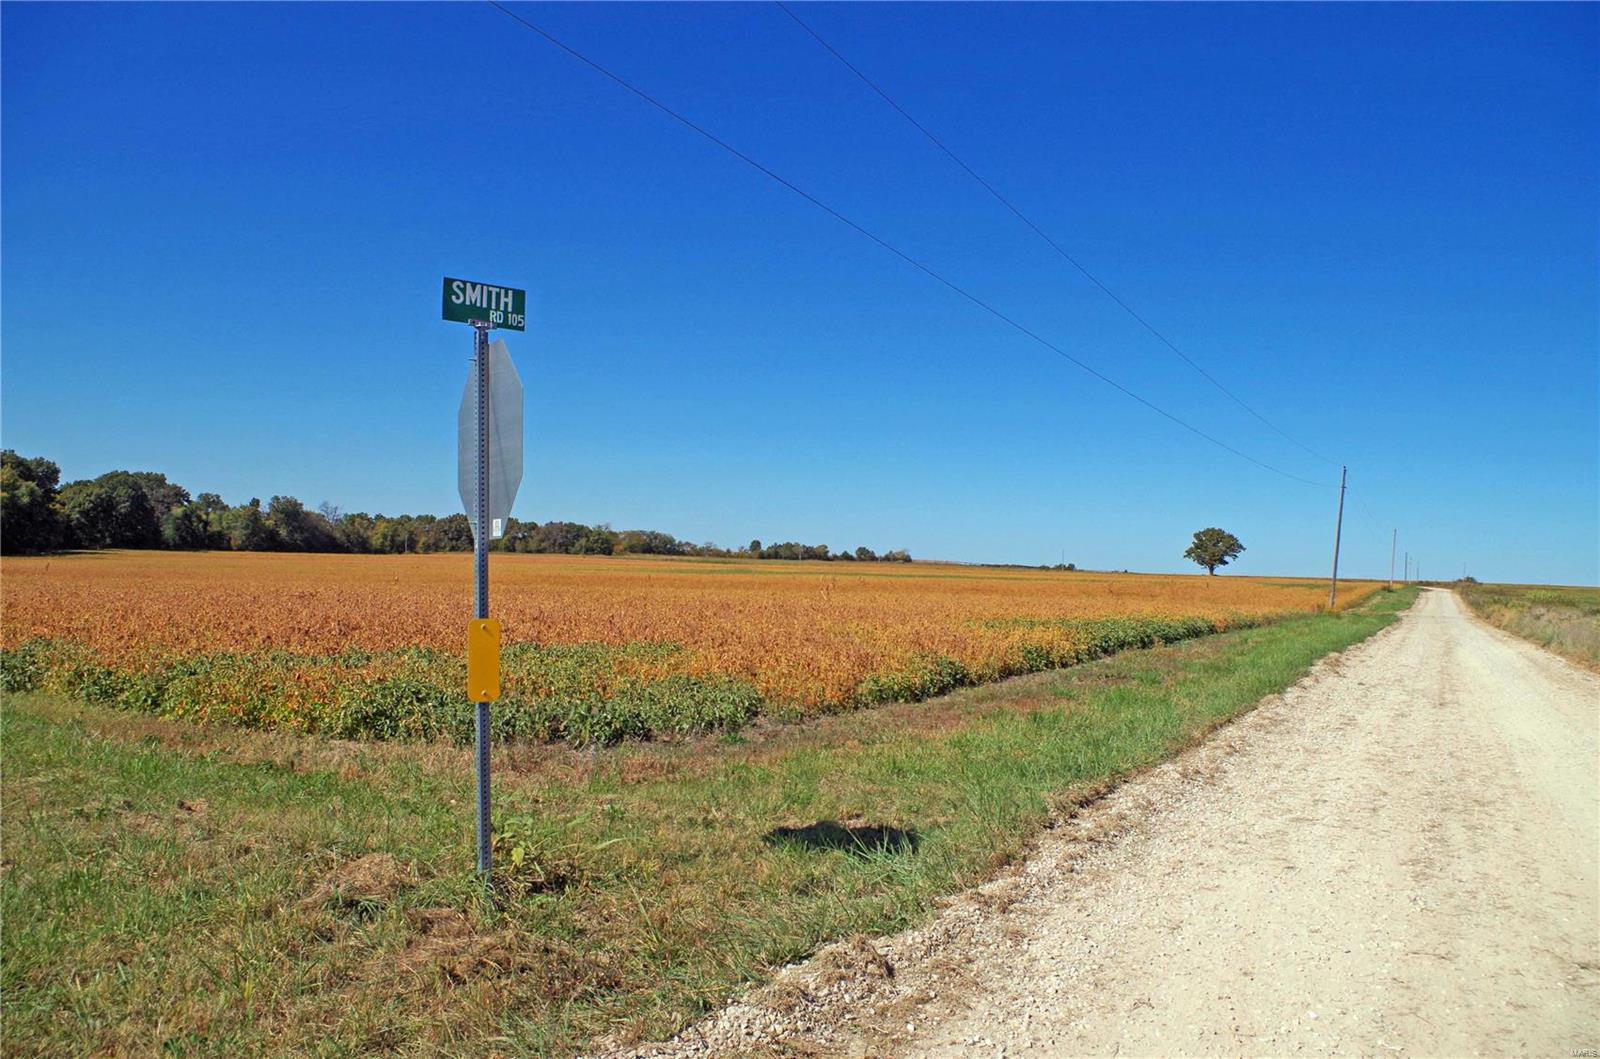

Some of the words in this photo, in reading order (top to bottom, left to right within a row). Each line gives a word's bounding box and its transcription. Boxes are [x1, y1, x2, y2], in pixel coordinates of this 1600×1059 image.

[451, 280, 513, 312] SMITH
[489, 310, 504, 323] RD
[508, 313, 524, 327] 105
